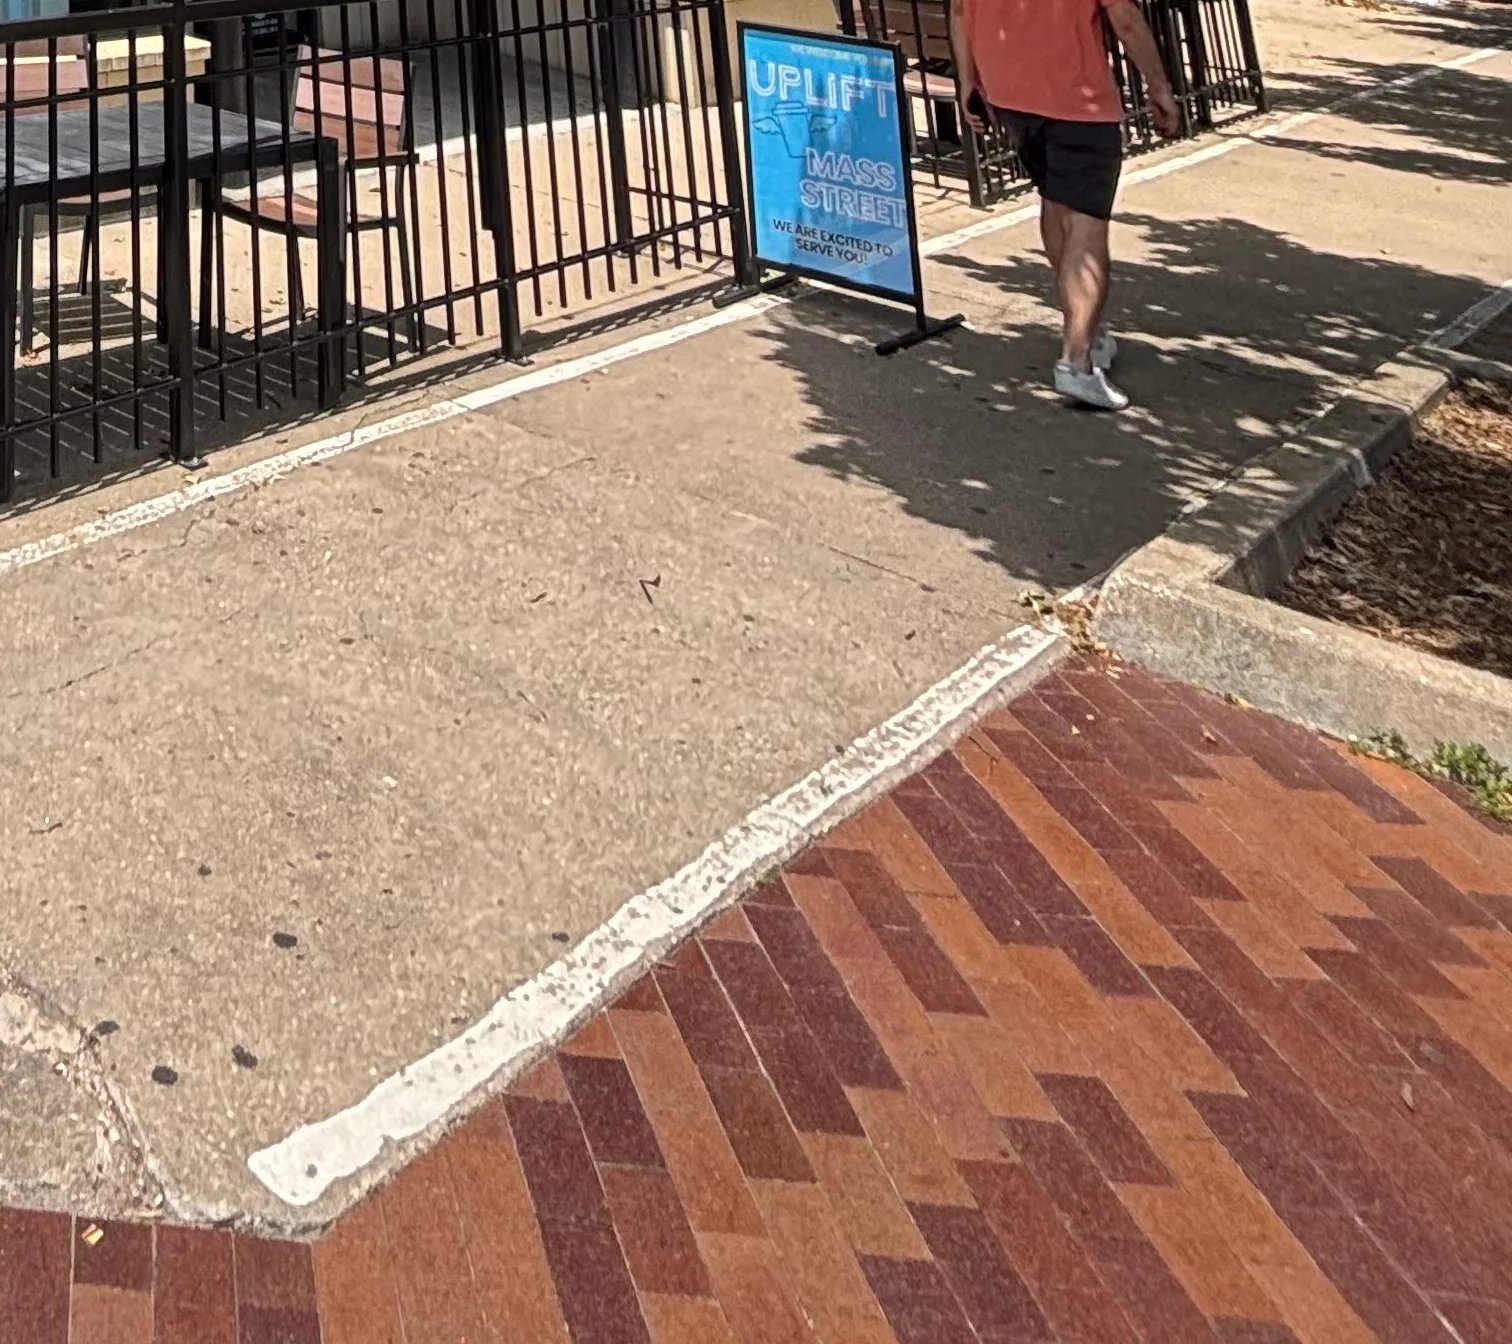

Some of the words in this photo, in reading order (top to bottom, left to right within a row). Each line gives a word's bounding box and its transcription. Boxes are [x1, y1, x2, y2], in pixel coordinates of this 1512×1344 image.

[749, 59, 895, 118] UPLIFT
[804, 147, 896, 192] MASS
[799, 179, 906, 229] STREET
[773, 218, 793, 234] WE
[795, 223, 818, 239] ARE
[820, 229, 873, 252] EXCITED
[874, 242, 894, 258] TO
[795, 238, 834, 258] SERVE
[835, 247, 868, 266] YOU!
